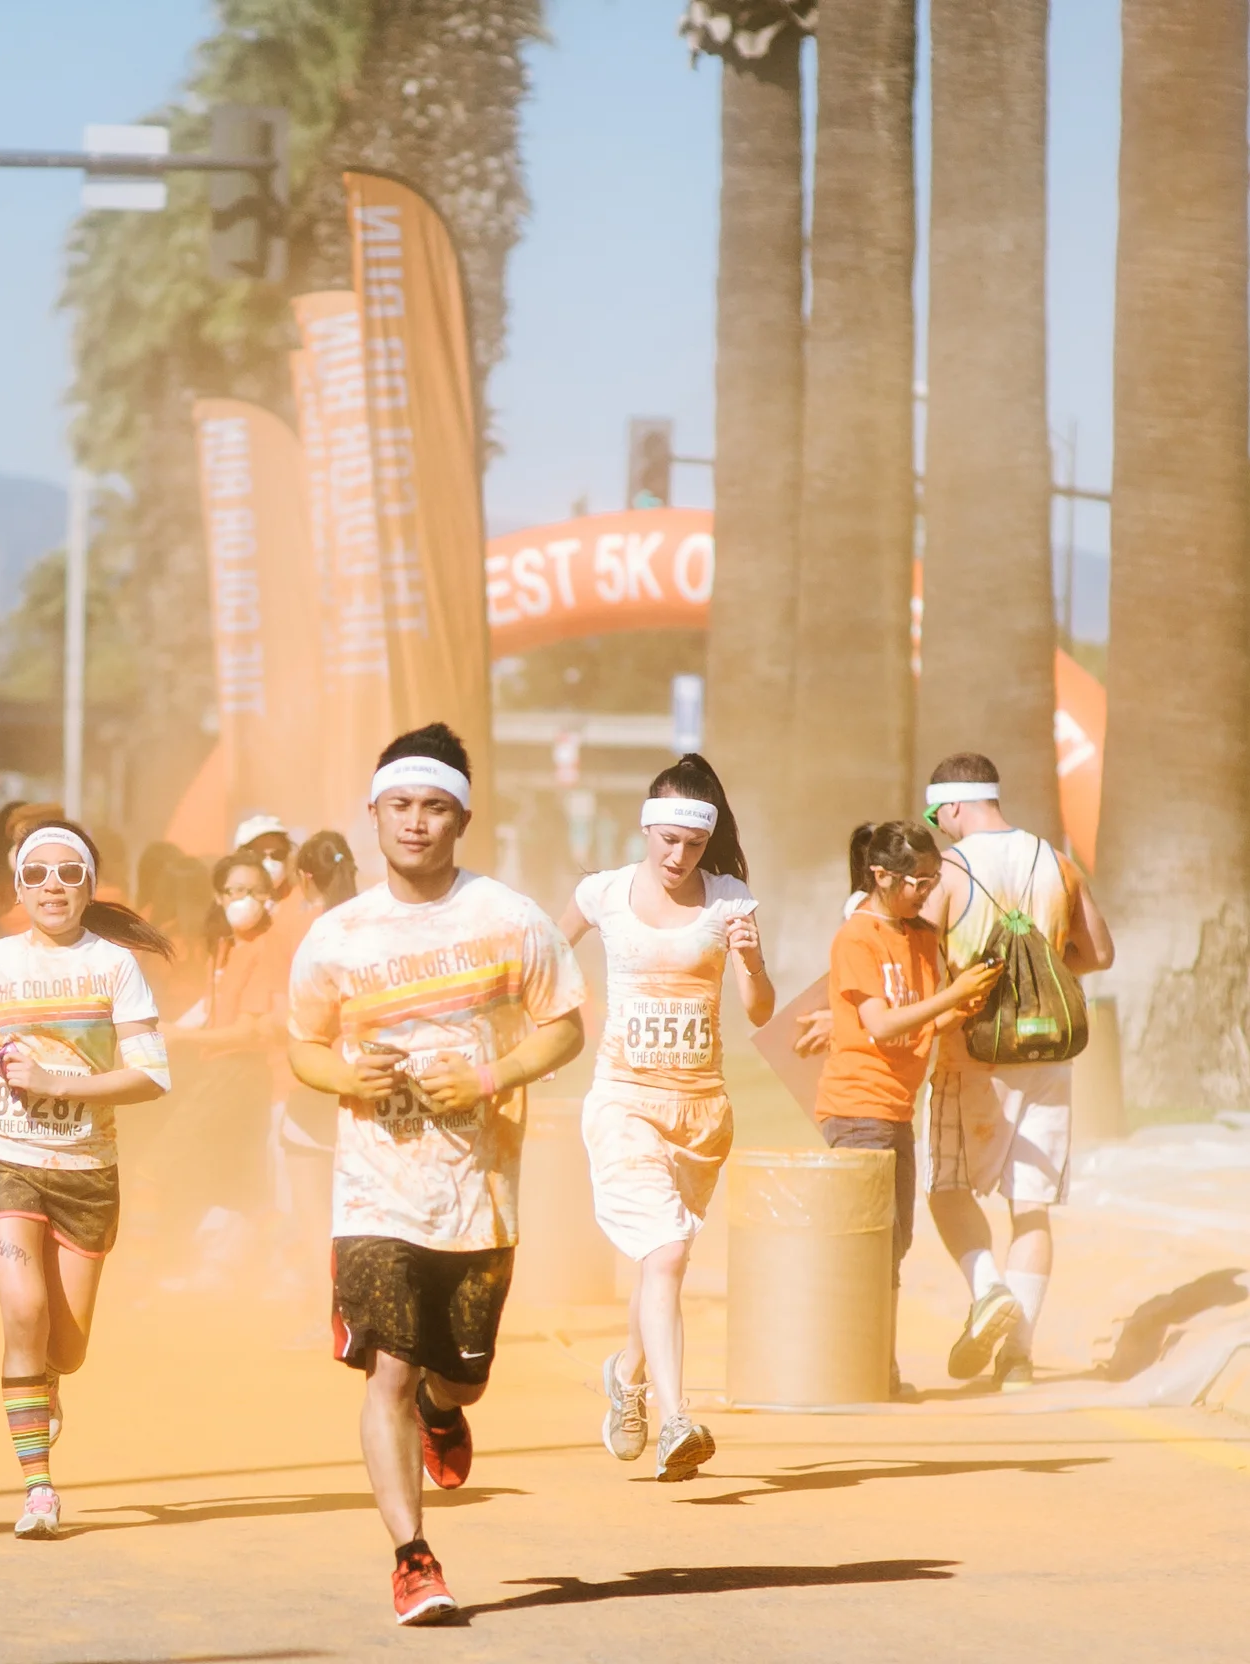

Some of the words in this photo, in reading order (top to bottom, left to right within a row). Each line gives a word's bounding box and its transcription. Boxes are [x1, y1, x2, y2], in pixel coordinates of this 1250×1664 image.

[594, 531, 665, 604] 5K
[673, 532, 715, 605] O
[347, 962, 386, 996] THE
[386, 946, 451, 987] COLOR
[22, 976, 74, 1000] COLOR
[633, 1002, 649, 1015] THE
[651, 1002, 682, 1015] COLOR
[684, 1002, 702, 1015] RUN
[627, 1016, 711, 1050] 85545
[631, 1051, 649, 1064] THE
[650, 1050, 680, 1065] COLOR
[682, 1051, 700, 1065] RUN
[17, 1119, 51, 1135] COLOR
[52, 1121, 73, 1137] RUN
[383, 1119, 402, 1134] THE
